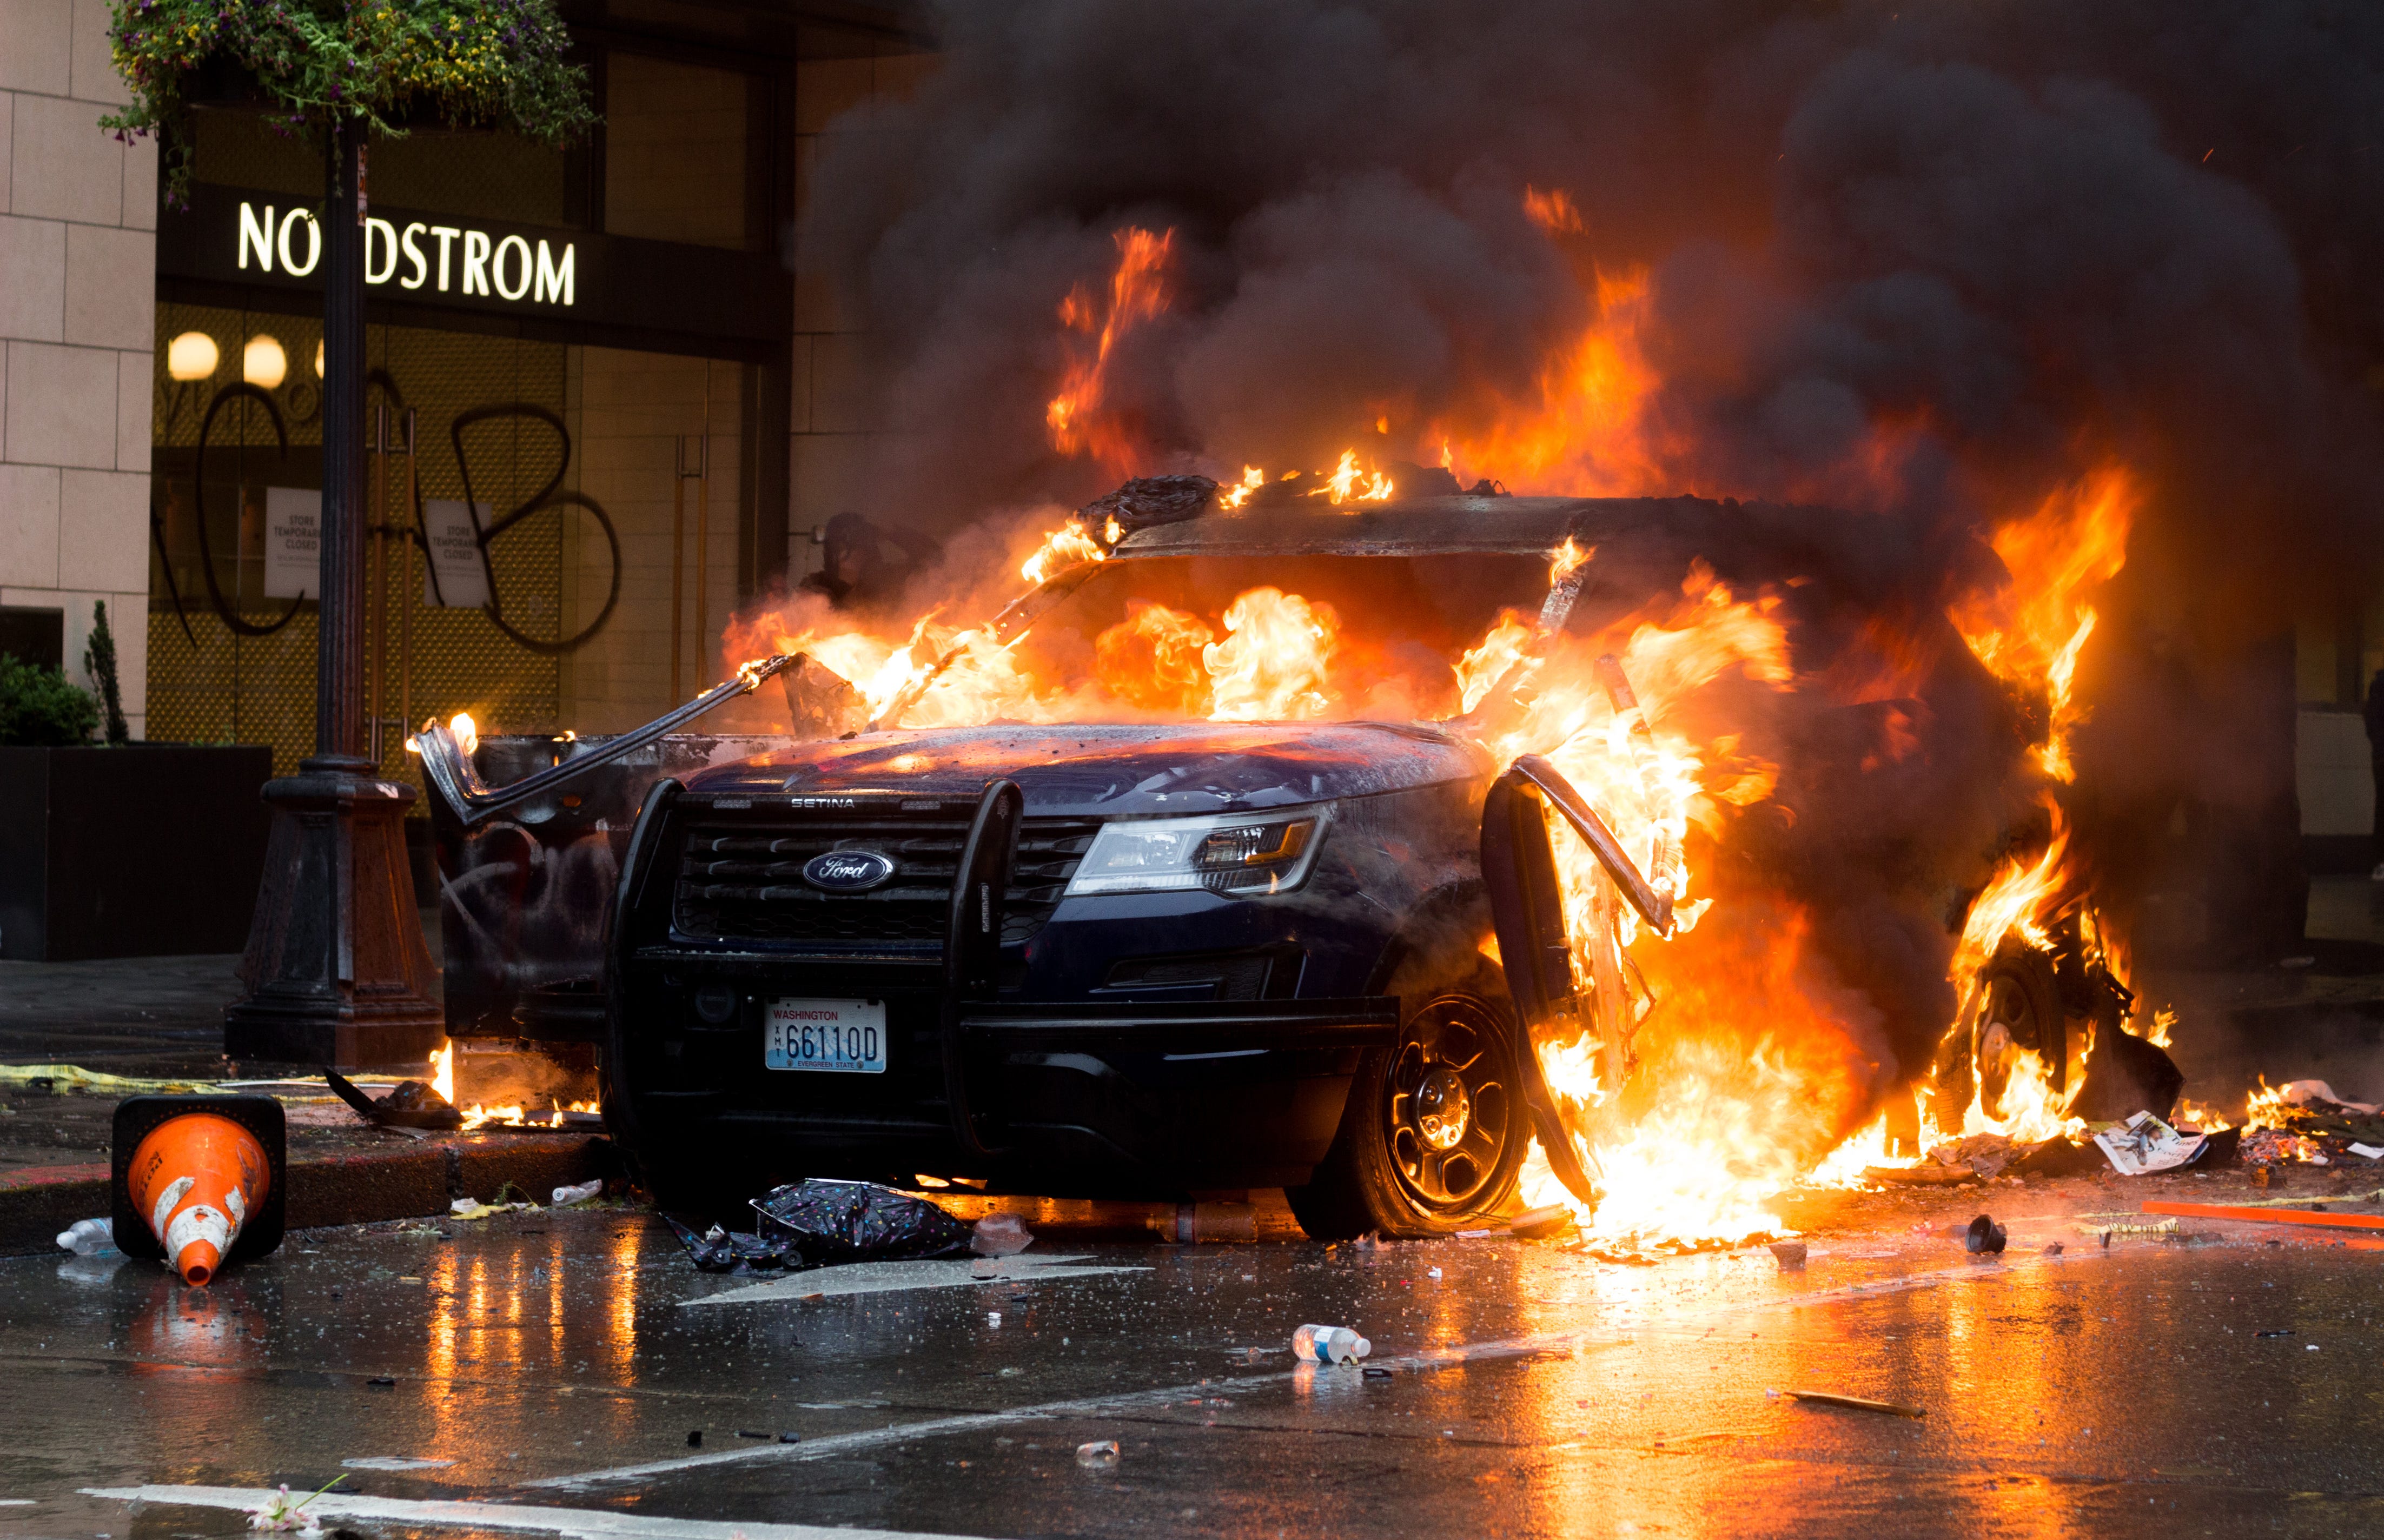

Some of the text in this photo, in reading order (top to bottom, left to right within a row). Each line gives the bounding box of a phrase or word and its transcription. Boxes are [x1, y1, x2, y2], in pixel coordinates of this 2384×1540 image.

[239, 202, 574, 306] NODSTROM
[289, 515, 314, 526] STORE
[447, 525, 470, 536] STORE
[285, 539, 317, 550] CLOSED
[443, 548, 473, 560] CLOSED
[791, 798, 855, 809] SETINA
[818, 857, 870, 879] Ford
[773, 1010, 838, 1021] WASHINGTON
[786, 1025, 877, 1061] 66110D
